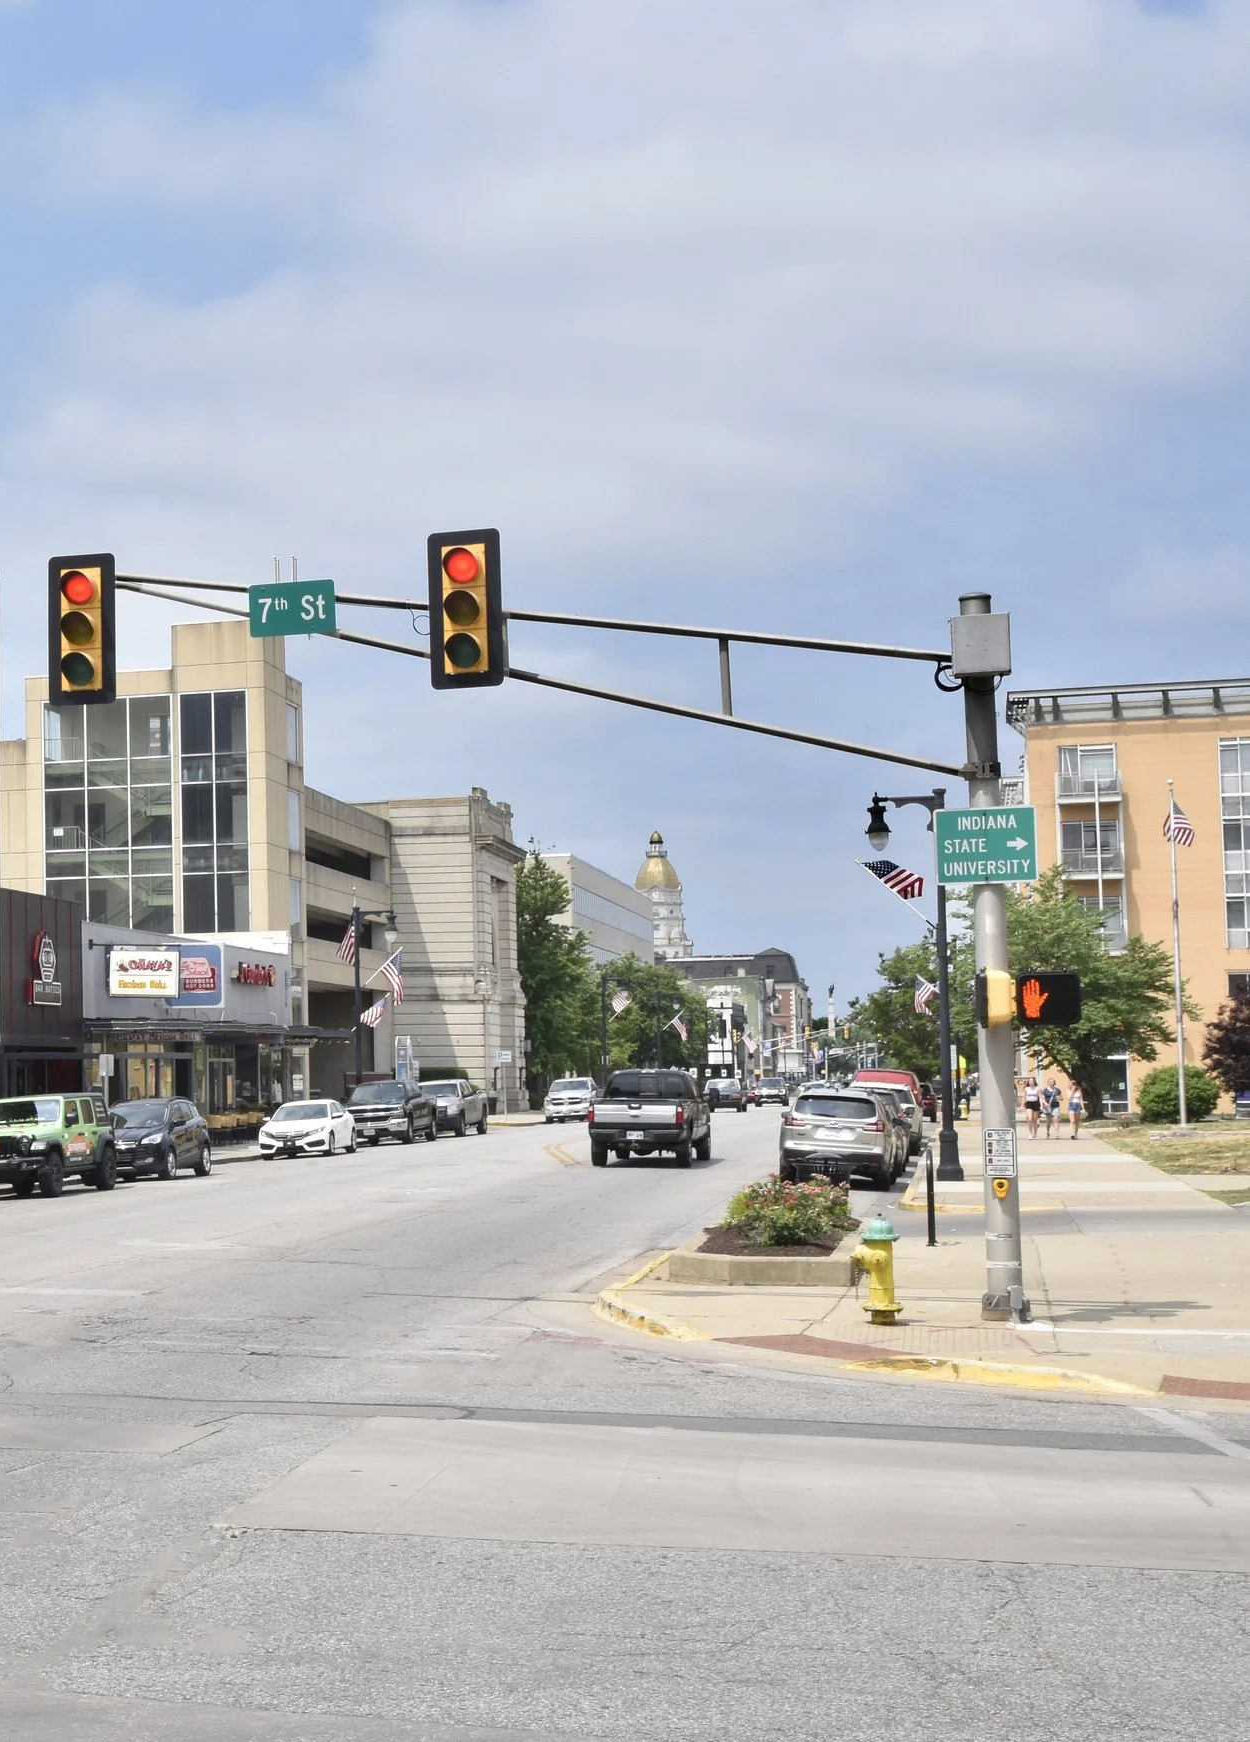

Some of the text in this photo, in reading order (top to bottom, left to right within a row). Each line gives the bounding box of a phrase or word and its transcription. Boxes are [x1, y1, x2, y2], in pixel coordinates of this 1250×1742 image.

[258, 594, 327, 624] 7th St
[957, 814, 1017, 831] INDIANA
[944, 838, 988, 854] STATE
[943, 859, 1031, 877] UNIVERSITY
